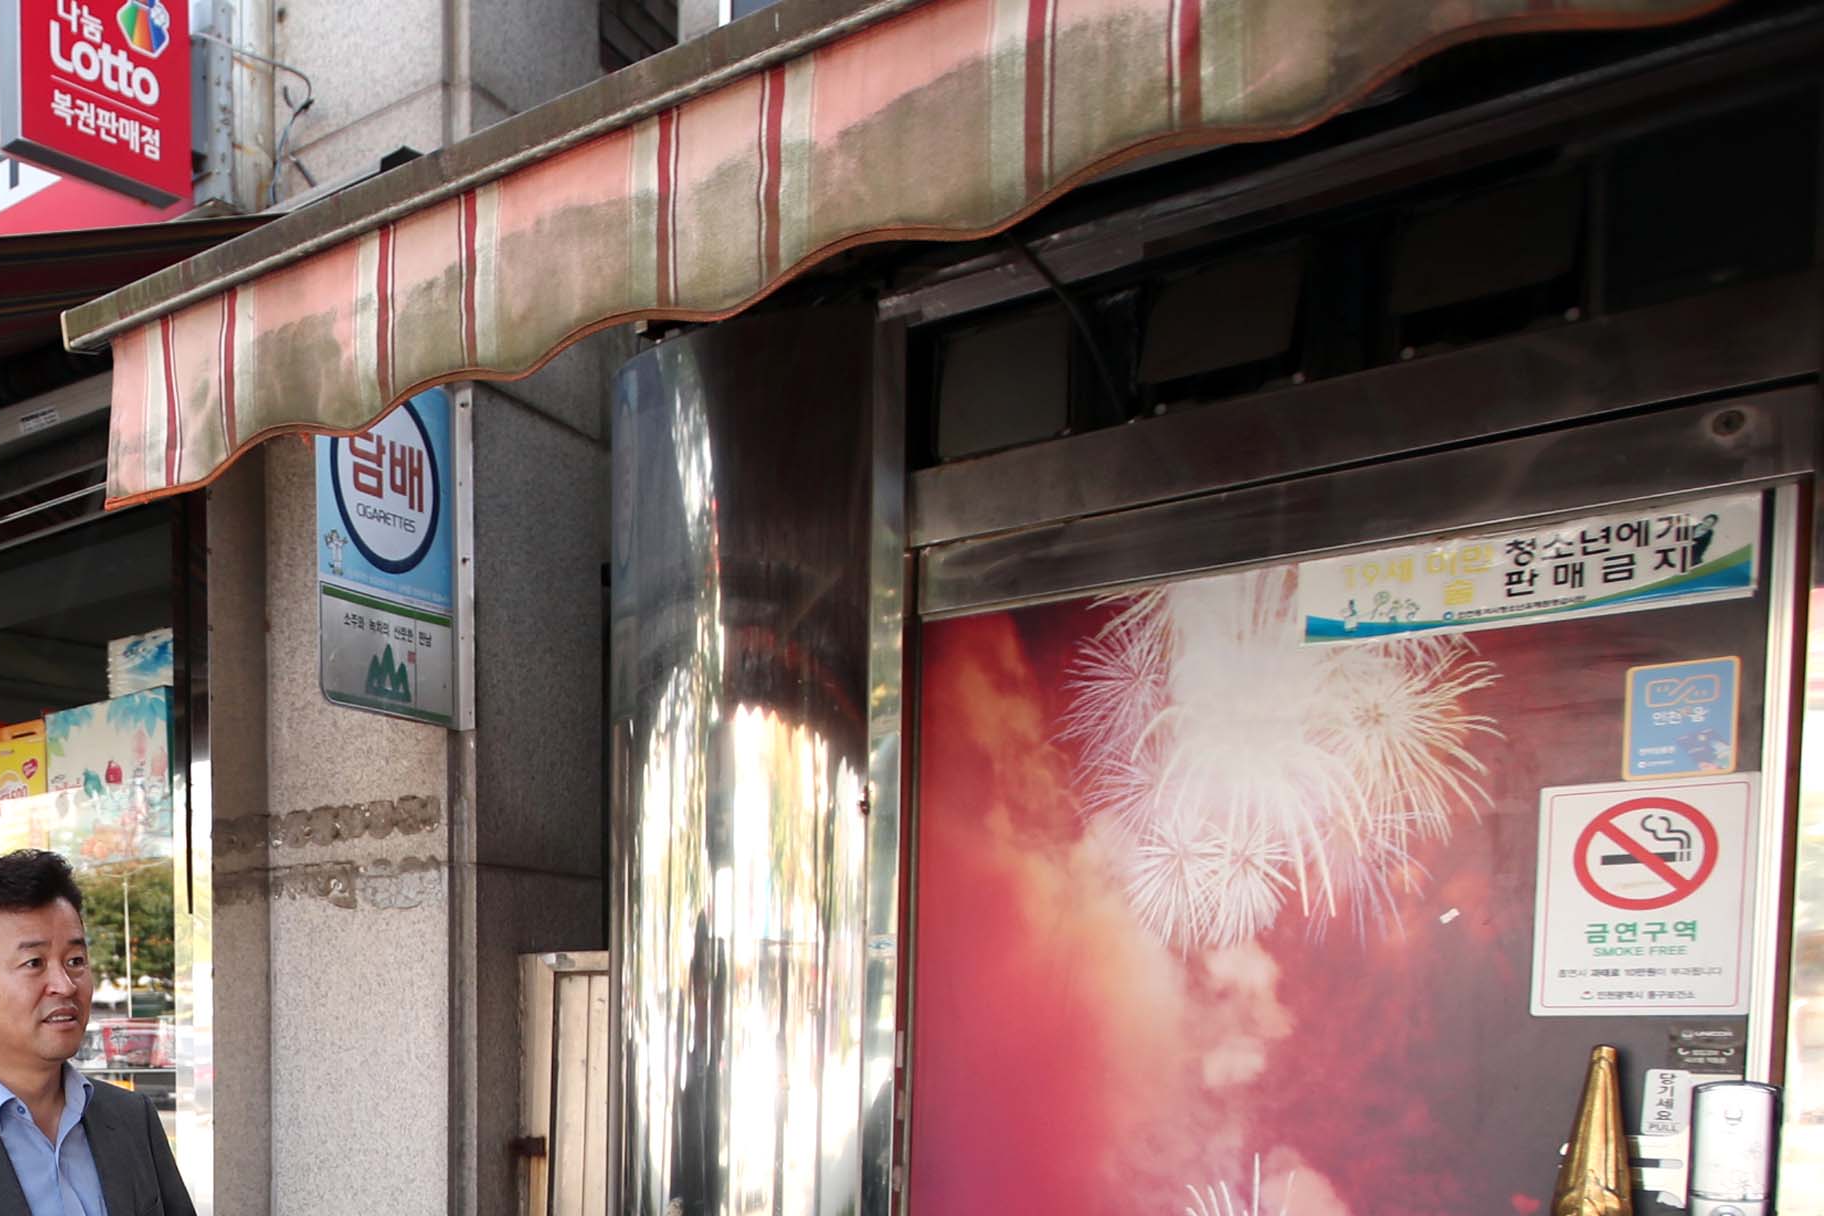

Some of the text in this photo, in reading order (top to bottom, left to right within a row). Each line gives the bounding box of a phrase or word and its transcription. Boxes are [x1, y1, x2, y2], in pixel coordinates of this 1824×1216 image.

[57, 0, 103, 43] 나눔
[50, 20, 159, 105] Lotto
[51, 89, 160, 160] 복권판매점
[349, 431, 424, 513] 담배
[1343, 557, 1414, 589] 19세
[1505, 514, 1690, 566] 청소년에게
[1442, 579, 1473, 606] 술
[1584, 920, 1697, 944] 금연구역
[1592, 945, 1688, 957] SMOKE FREE
[1655, 1072, 1676, 1121] 당기세요
